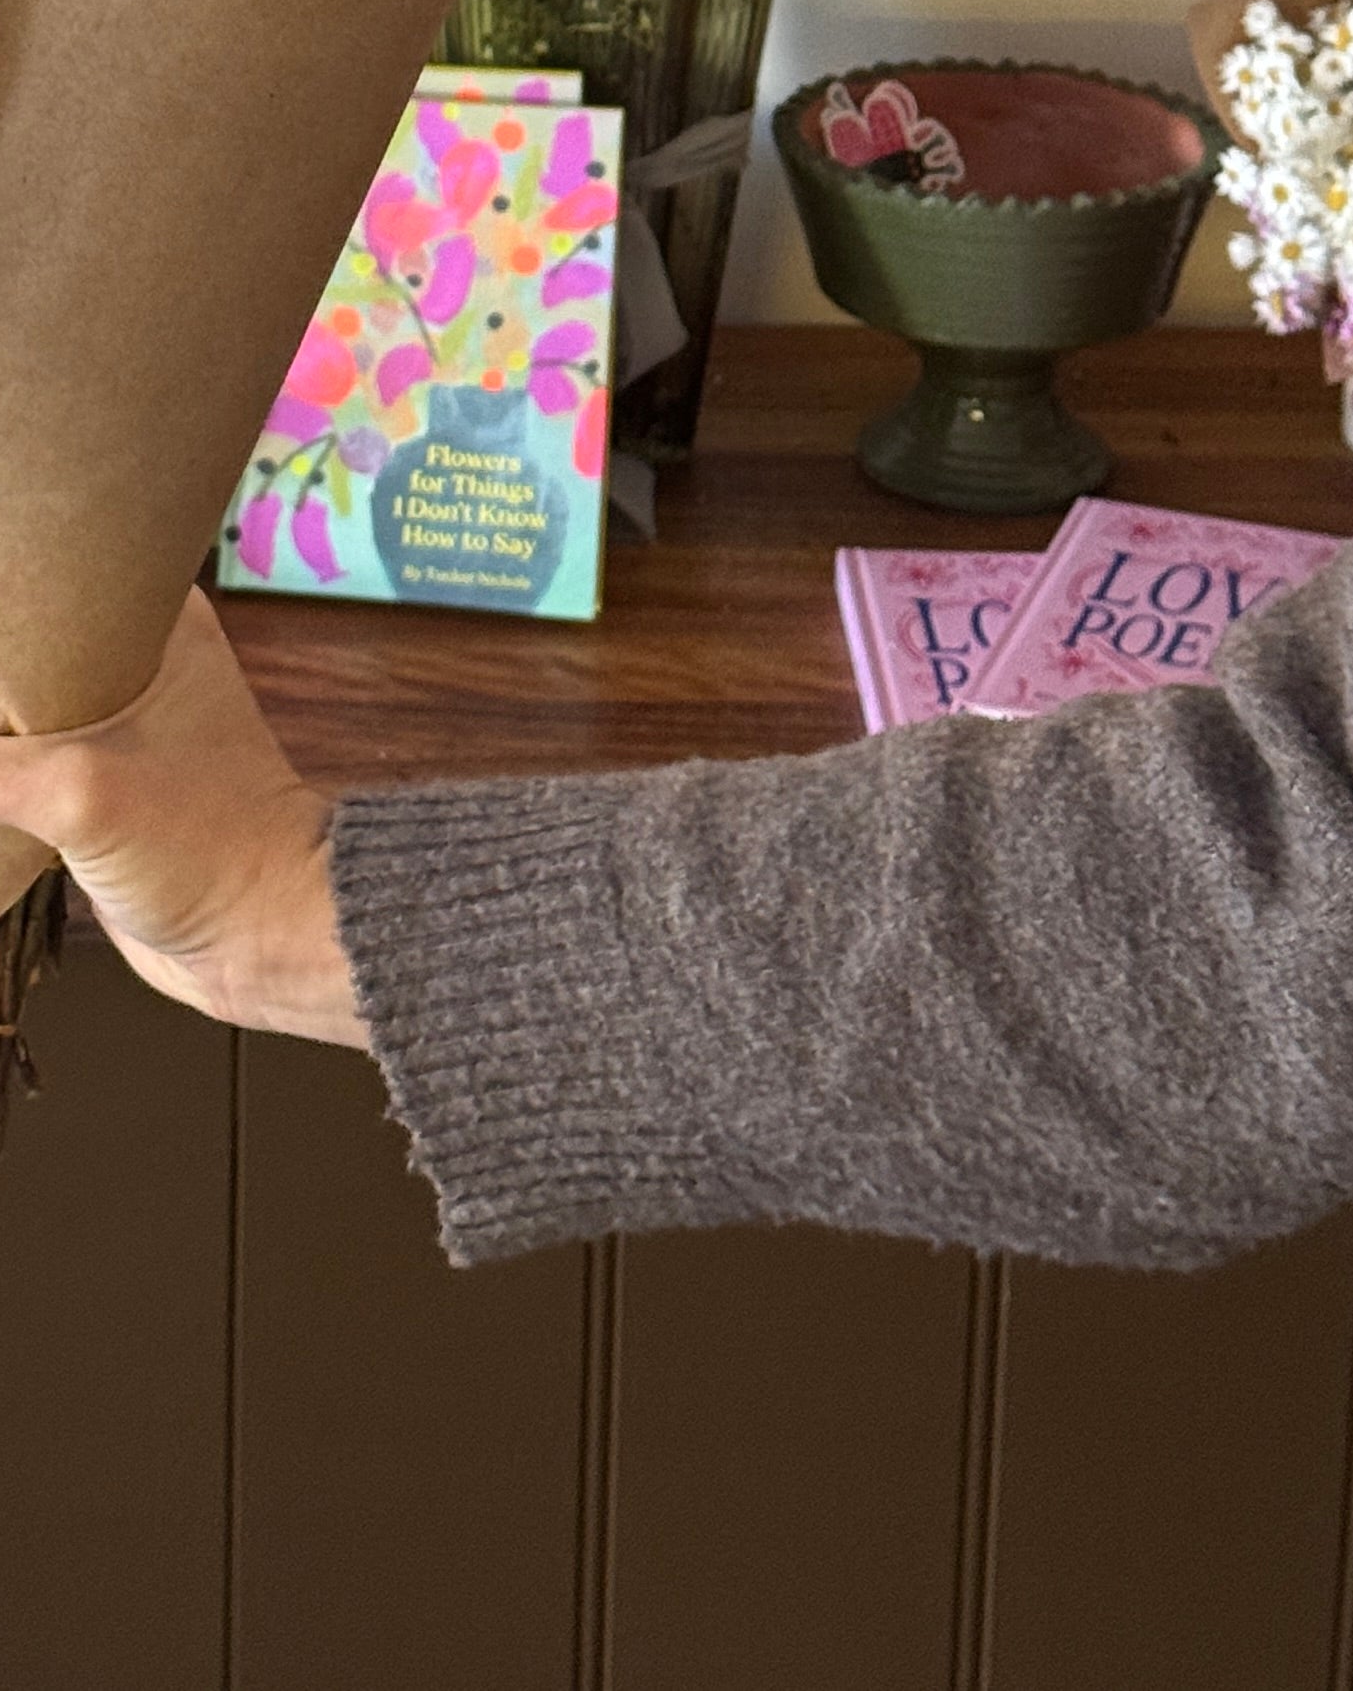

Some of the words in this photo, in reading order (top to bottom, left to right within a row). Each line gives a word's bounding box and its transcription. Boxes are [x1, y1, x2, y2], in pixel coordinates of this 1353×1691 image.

[425, 443, 522, 473] Flowers
[410, 469, 446, 494] for
[451, 472, 534, 504] Things
[393, 495, 403, 518] I
[406, 496, 473, 522] Don't
[477, 502, 548, 530] Know
[401, 523, 457, 548] How
[461, 531, 489, 551] to
[492, 532, 536, 561] Say
[1060, 605, 1214, 670] POE
